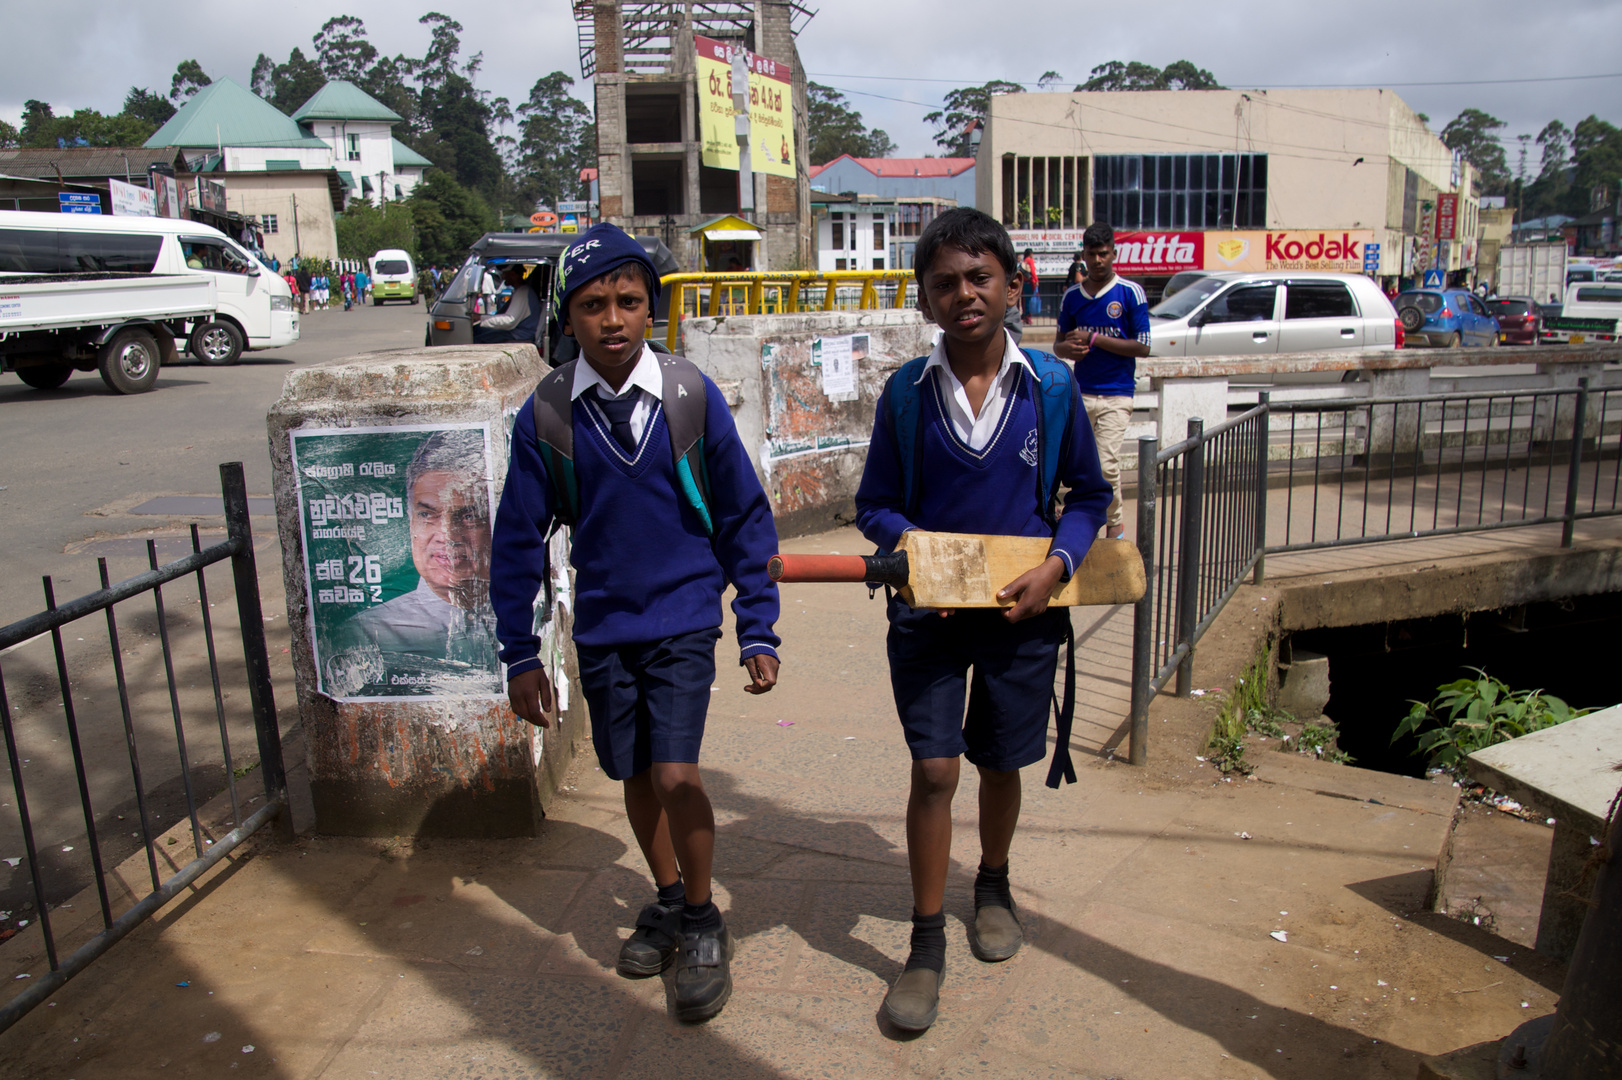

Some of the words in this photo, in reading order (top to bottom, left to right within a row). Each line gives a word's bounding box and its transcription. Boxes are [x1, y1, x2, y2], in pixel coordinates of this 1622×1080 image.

[1265, 233, 1360, 260] Kodak
[1266, 261, 1279, 270] The
[1280, 260, 1303, 270] World's
[1305, 261, 1319, 270] Best
[1320, 260, 1344, 272] Selling
[1345, 260, 1360, 270] Film
[348, 555, 382, 584] 26
[318, 585, 365, 604] සවස
[369, 585, 383, 603] 2
